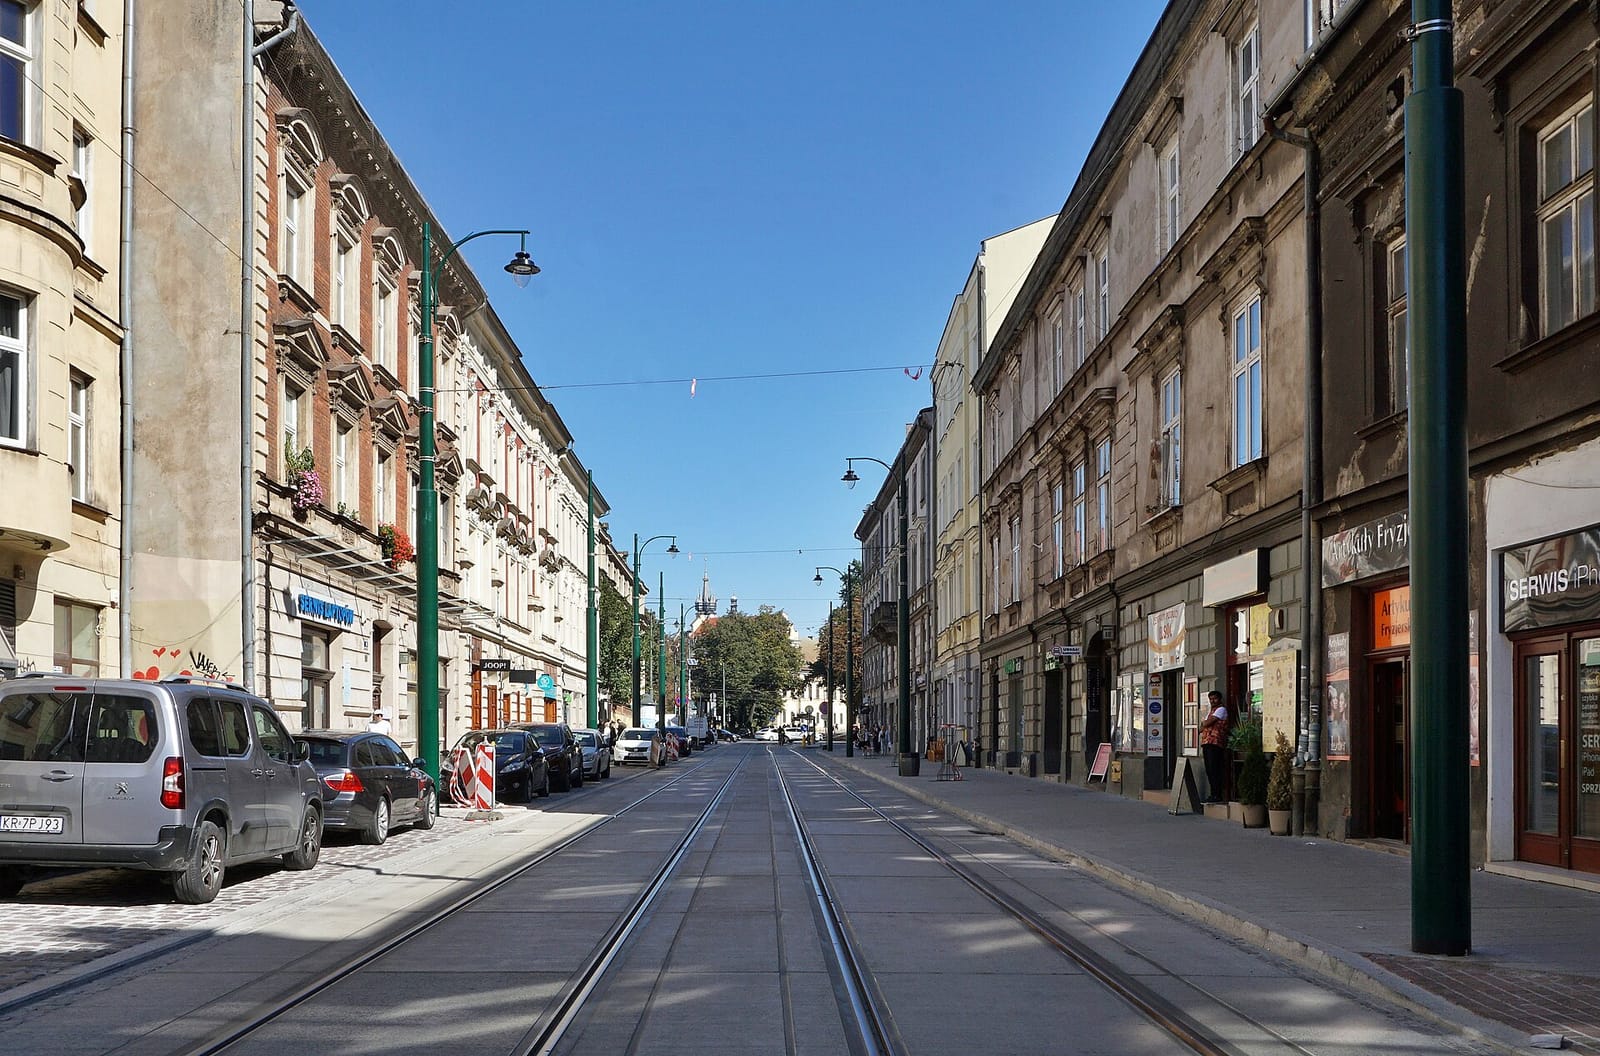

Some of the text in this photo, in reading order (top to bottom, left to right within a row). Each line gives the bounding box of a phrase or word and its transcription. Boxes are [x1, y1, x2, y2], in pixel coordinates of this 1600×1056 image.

[1377, 514, 1411, 552] Fryzj
[1509, 564, 1600, 601] SERWIS iPh
[1582, 734, 1600, 748] SER
[1581, 783, 1600, 794] SPRZ
[2, 817, 59, 830] KR 7PJ93
